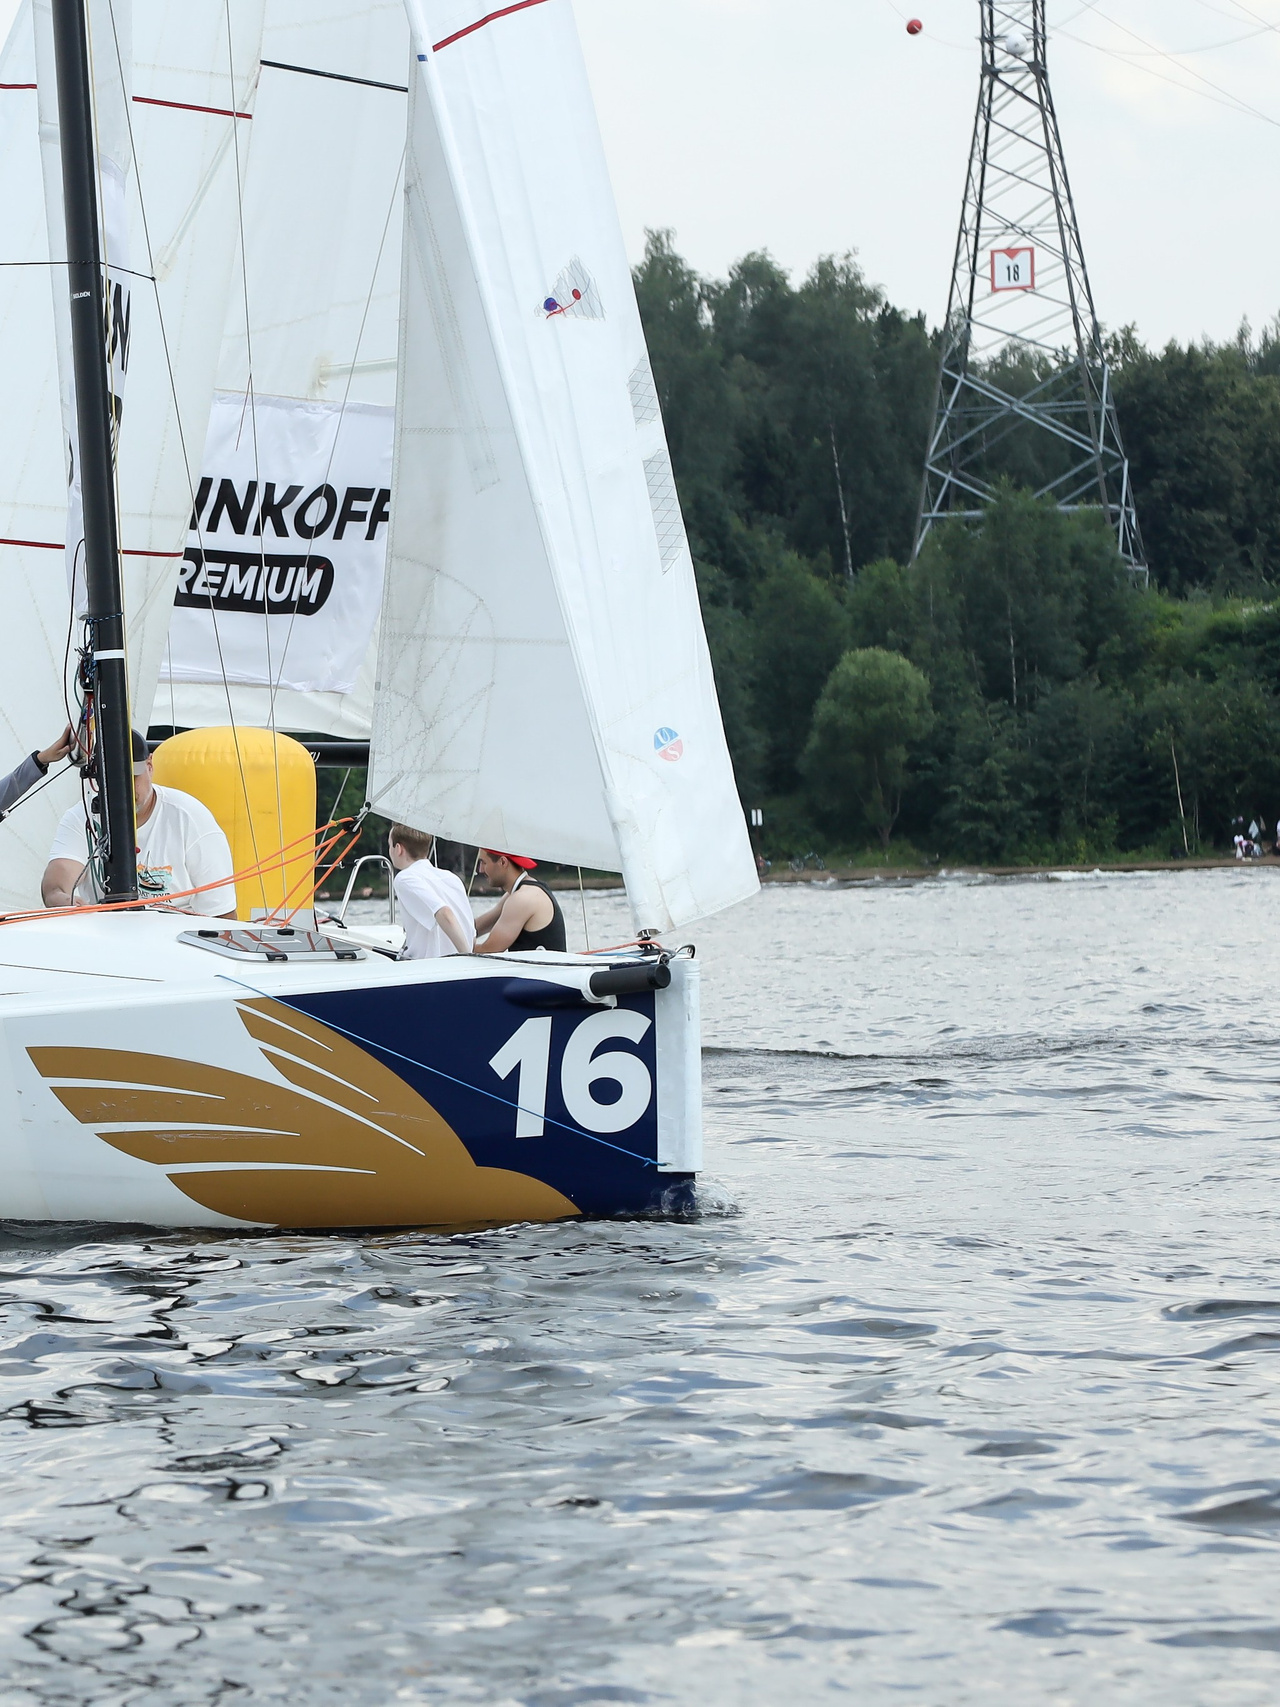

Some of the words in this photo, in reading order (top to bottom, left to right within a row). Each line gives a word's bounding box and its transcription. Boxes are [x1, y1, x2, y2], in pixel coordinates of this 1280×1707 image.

[1006, 264, 1020, 283] 18
[189, 477, 391, 540] INKOFF
[176, 559, 324, 603] REMIUM
[488, 1009, 652, 1138] 16
